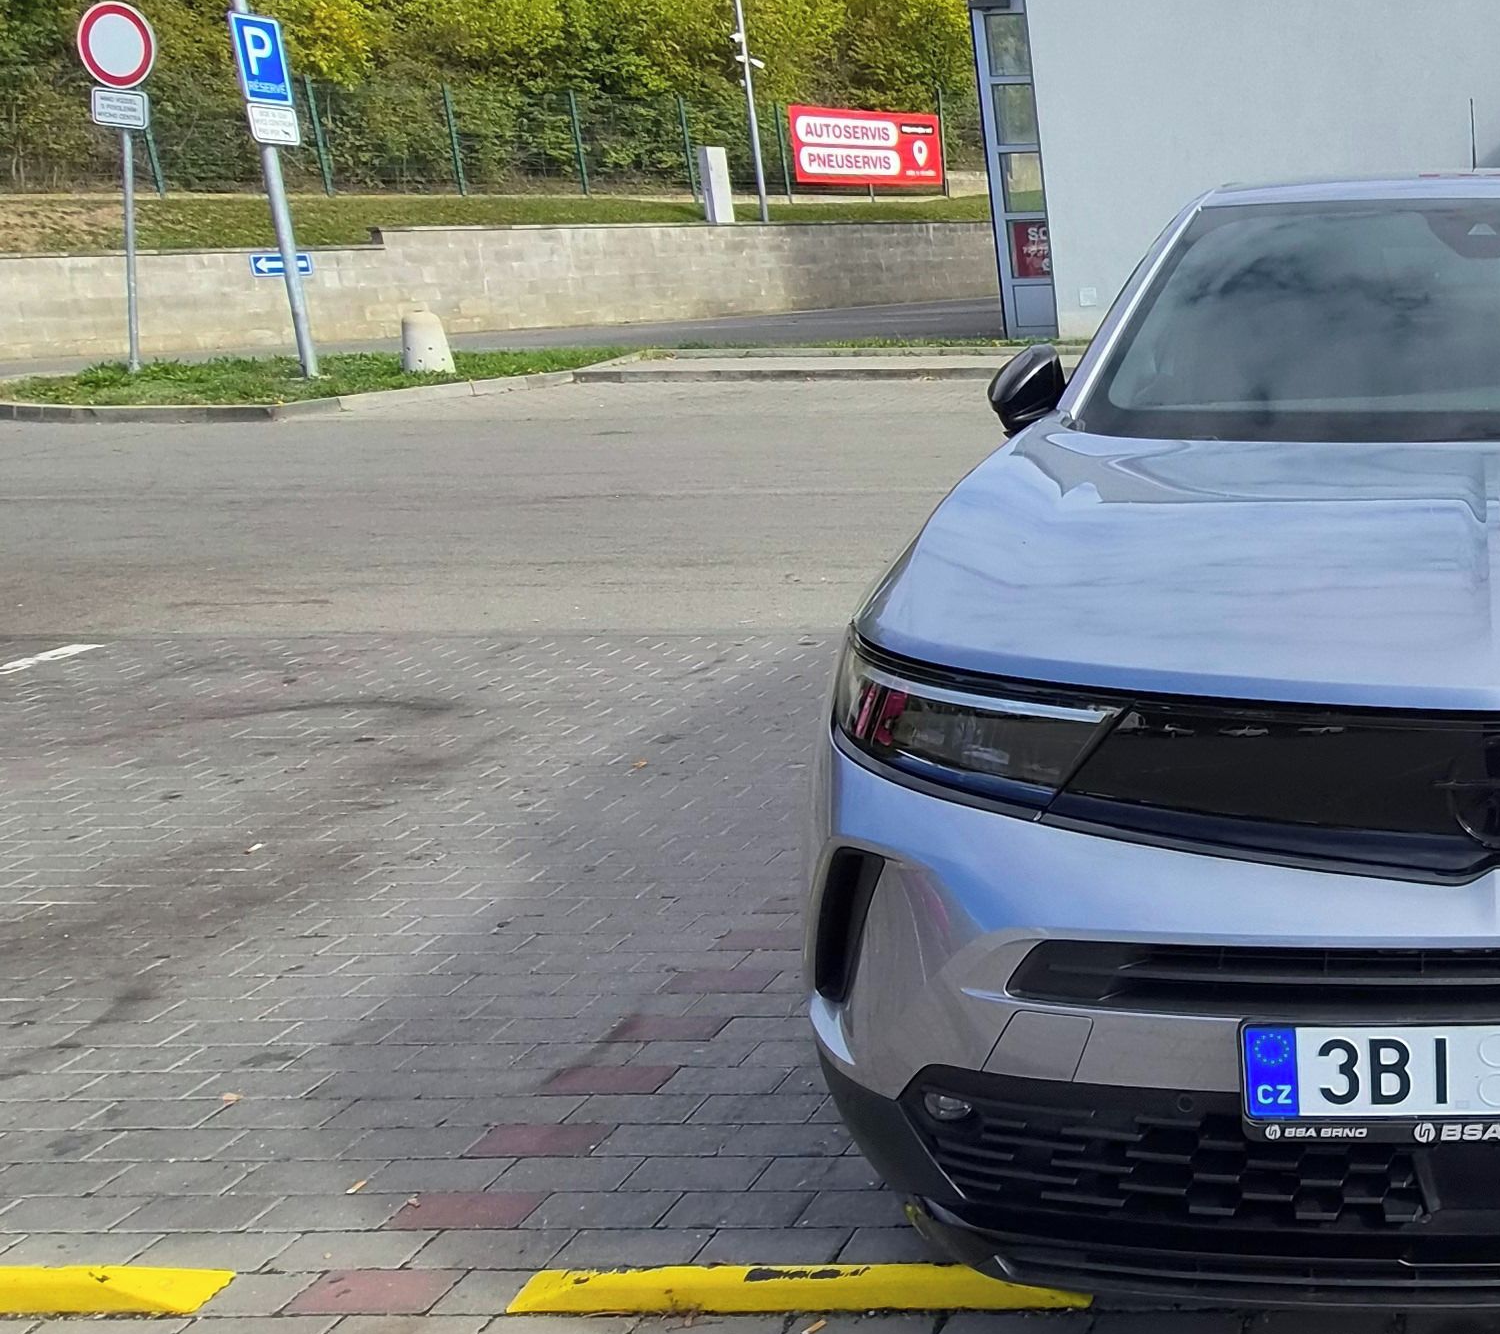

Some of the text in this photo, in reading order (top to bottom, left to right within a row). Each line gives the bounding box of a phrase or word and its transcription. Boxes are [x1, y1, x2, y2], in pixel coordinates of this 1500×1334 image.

[243, 25, 272, 76] P
[805, 122, 890, 142] AUTOSERVIS
[808, 152, 892, 170] PNEUSERVIS
[1257, 1084, 1292, 1104] CZ
[1318, 1038, 1448, 1105] 3BI
[1320, 1127, 1368, 1138] BRNO
